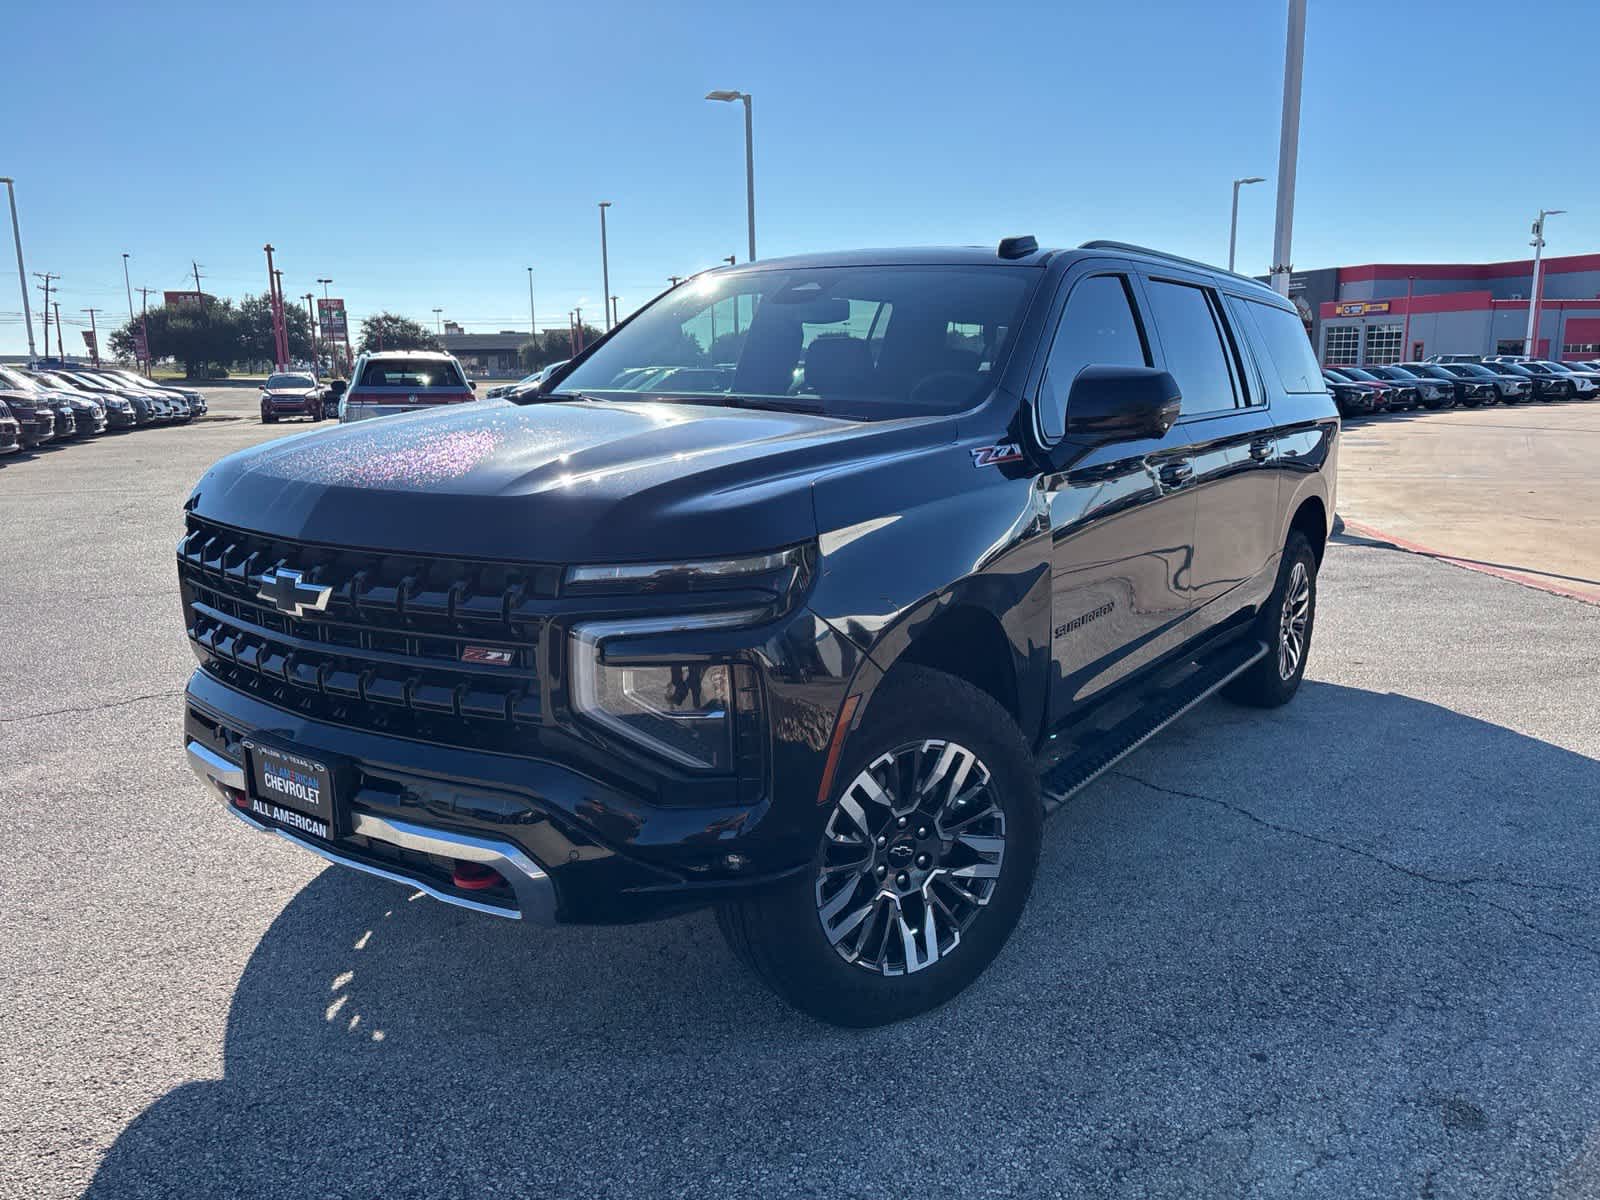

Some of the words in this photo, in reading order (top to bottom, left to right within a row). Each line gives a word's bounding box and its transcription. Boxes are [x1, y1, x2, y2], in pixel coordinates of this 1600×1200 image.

[970, 443, 1023, 468] Z71
[1054, 601, 1115, 639] SUBURBAN
[462, 646, 512, 665] Z71
[264, 772, 320, 805] CHEVROLET
[253, 799, 271, 817] ALL
[272, 807, 327, 838] AMERICAN
